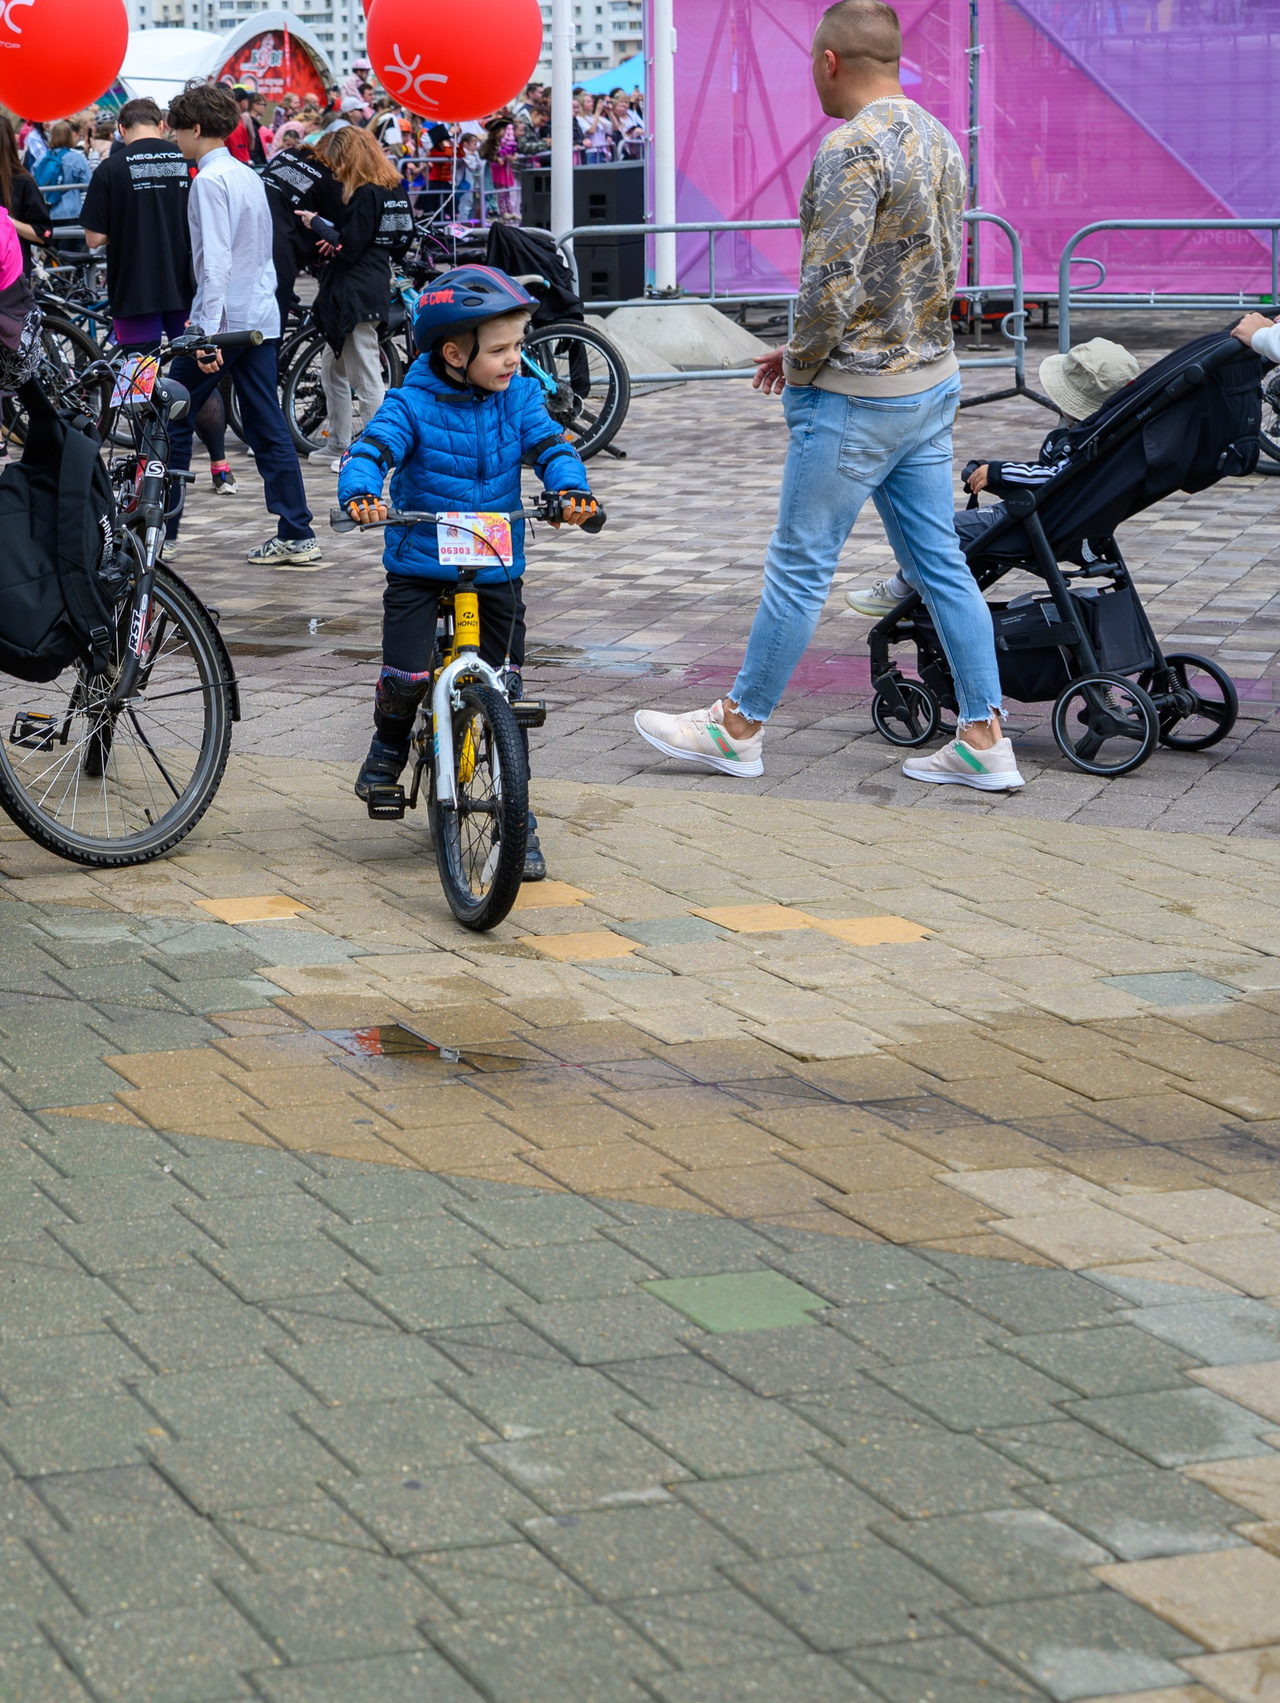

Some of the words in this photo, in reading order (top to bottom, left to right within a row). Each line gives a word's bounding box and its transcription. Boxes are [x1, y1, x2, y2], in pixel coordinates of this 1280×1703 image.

[384, 200, 408, 208] MEGATO
[419, 292, 430, 308] BE
[429, 289, 455, 306] COOL
[440, 547, 471, 555] 06303
[128, 610, 142, 652] RST
